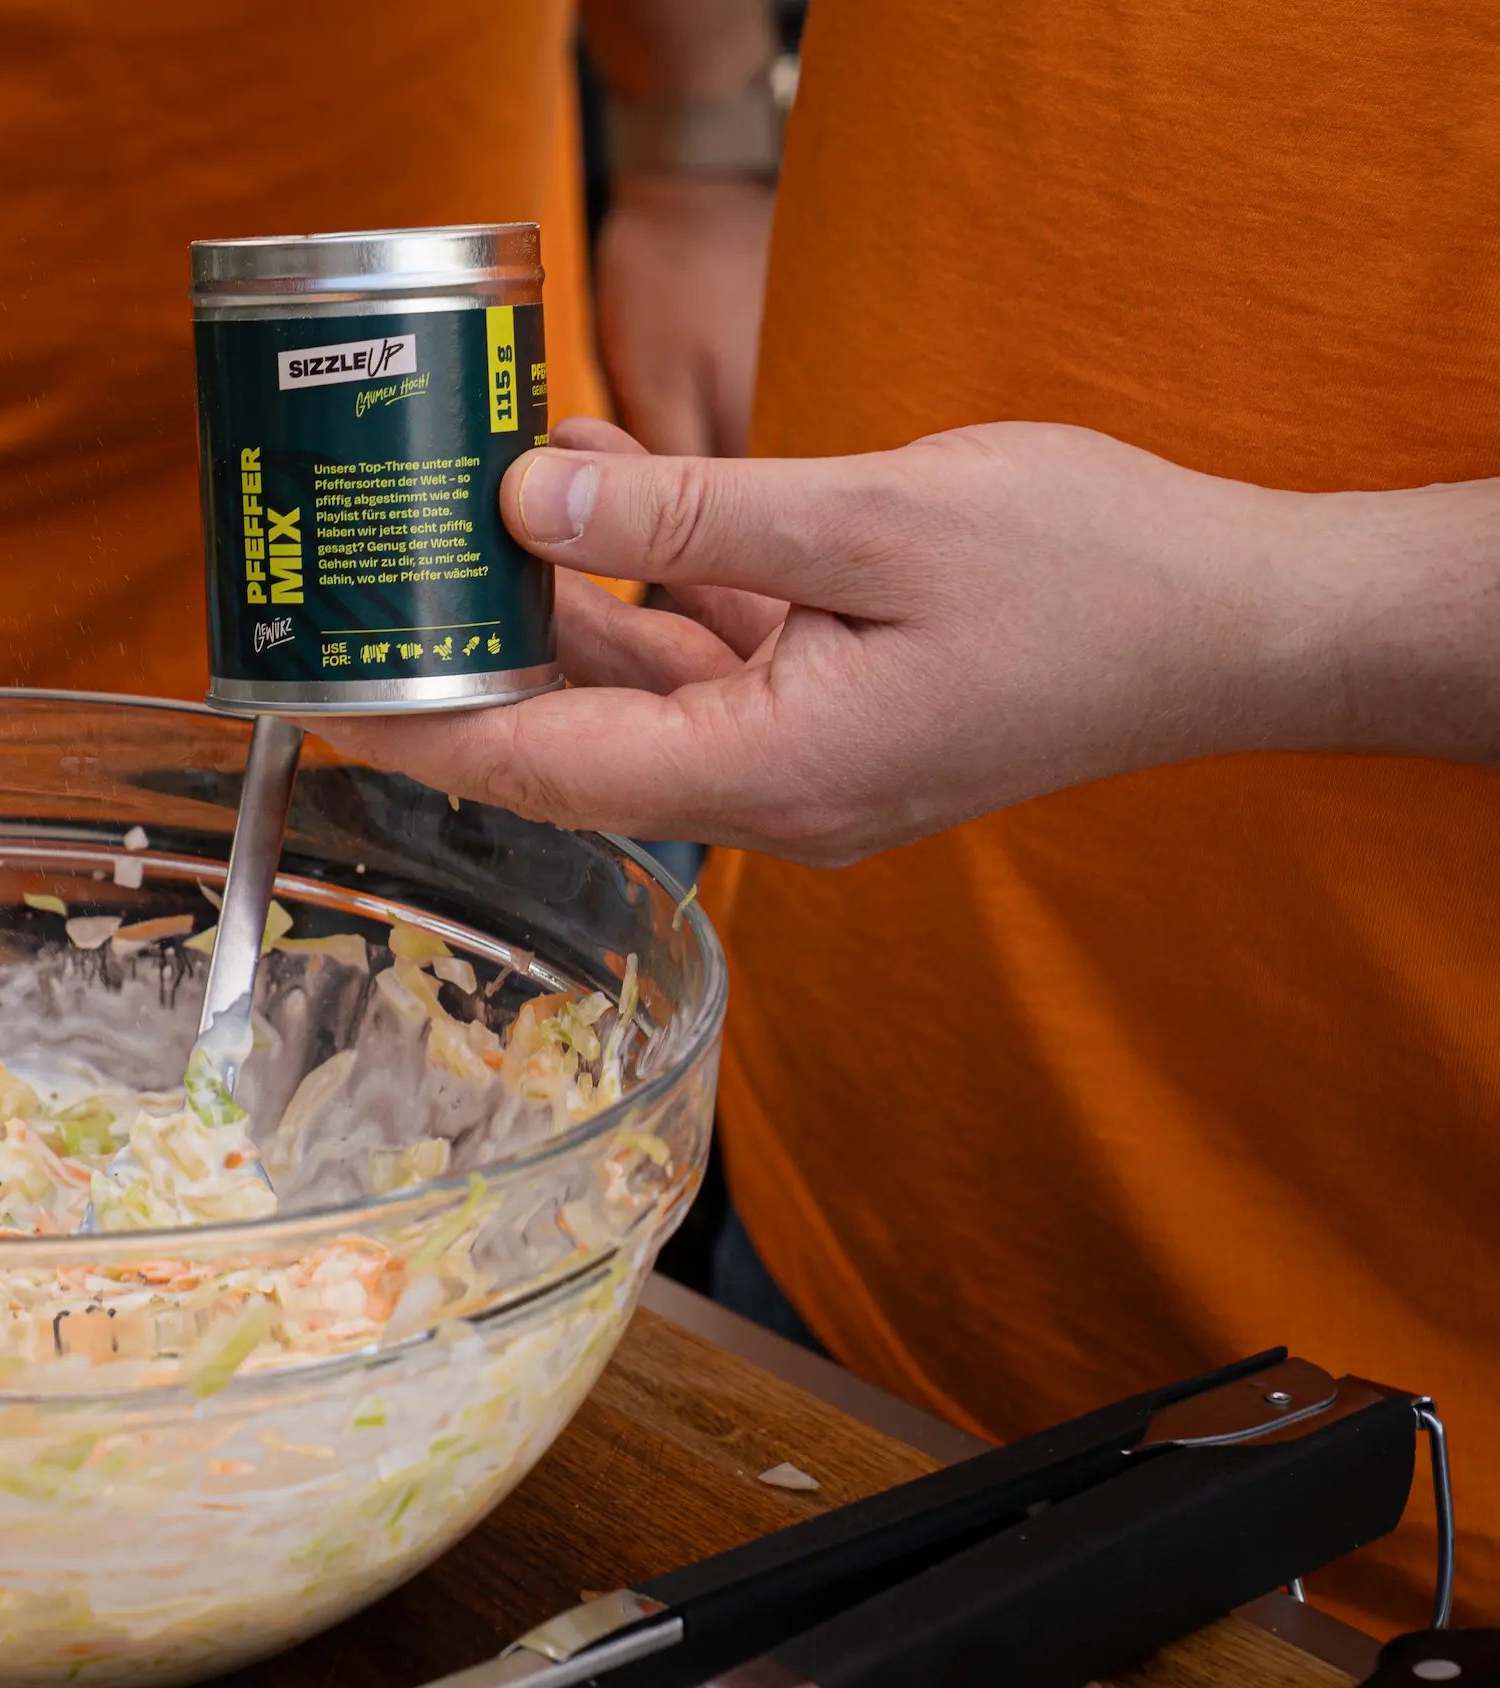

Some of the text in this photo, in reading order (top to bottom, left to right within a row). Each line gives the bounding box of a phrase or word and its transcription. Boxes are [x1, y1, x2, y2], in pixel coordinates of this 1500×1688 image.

[495, 344, 513, 421] 115 g
[314, 456, 480, 474] Unsere Top-Three unter allen
[315, 476, 396, 490] Pfeffersorten
[398, 475, 418, 487] der
[420, 474, 446, 485] Welt
[458, 473, 470, 483] so
[316, 489, 469, 508] pfiffig abgestimmt wie die
[316, 506, 452, 524] Playlist fürs erste Date.
[240, 446, 267, 604] PFEFFER
[317, 520, 473, 538] Haben wir jetzt echt pfiffig
[267, 506, 304, 604] MIX
[318, 537, 468, 556] gesagt? Genug der Worte.
[318, 551, 481, 570] Gehen wir zu dir, zu mir oder
[319, 565, 489, 586] dahin, wo der Pfeffer wächst?
[321, 641, 348, 655] USE
[322, 654, 351, 668] FOR:
